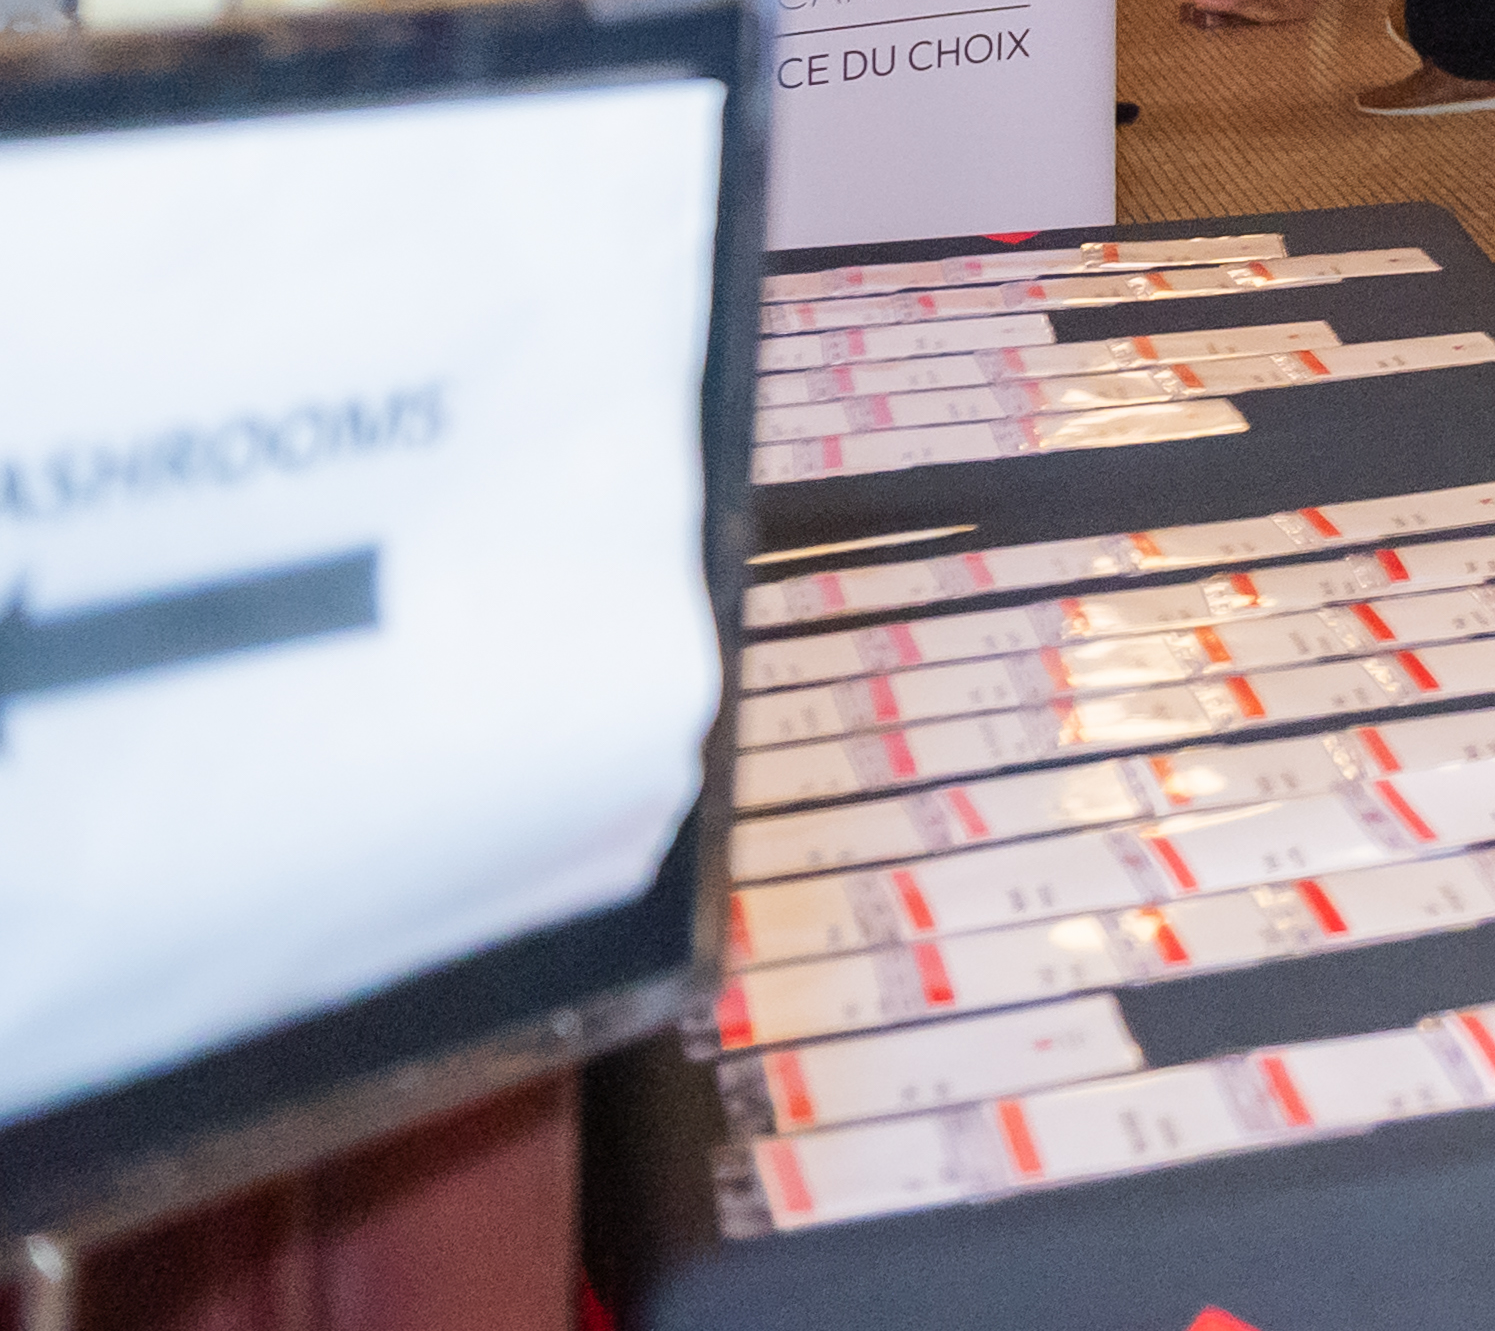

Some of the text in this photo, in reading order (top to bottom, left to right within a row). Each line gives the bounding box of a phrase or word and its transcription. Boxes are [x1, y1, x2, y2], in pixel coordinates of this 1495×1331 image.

[776, 27, 1032, 90] CE DU CHOIX
[0, 384, 444, 520] ASHROOMS
